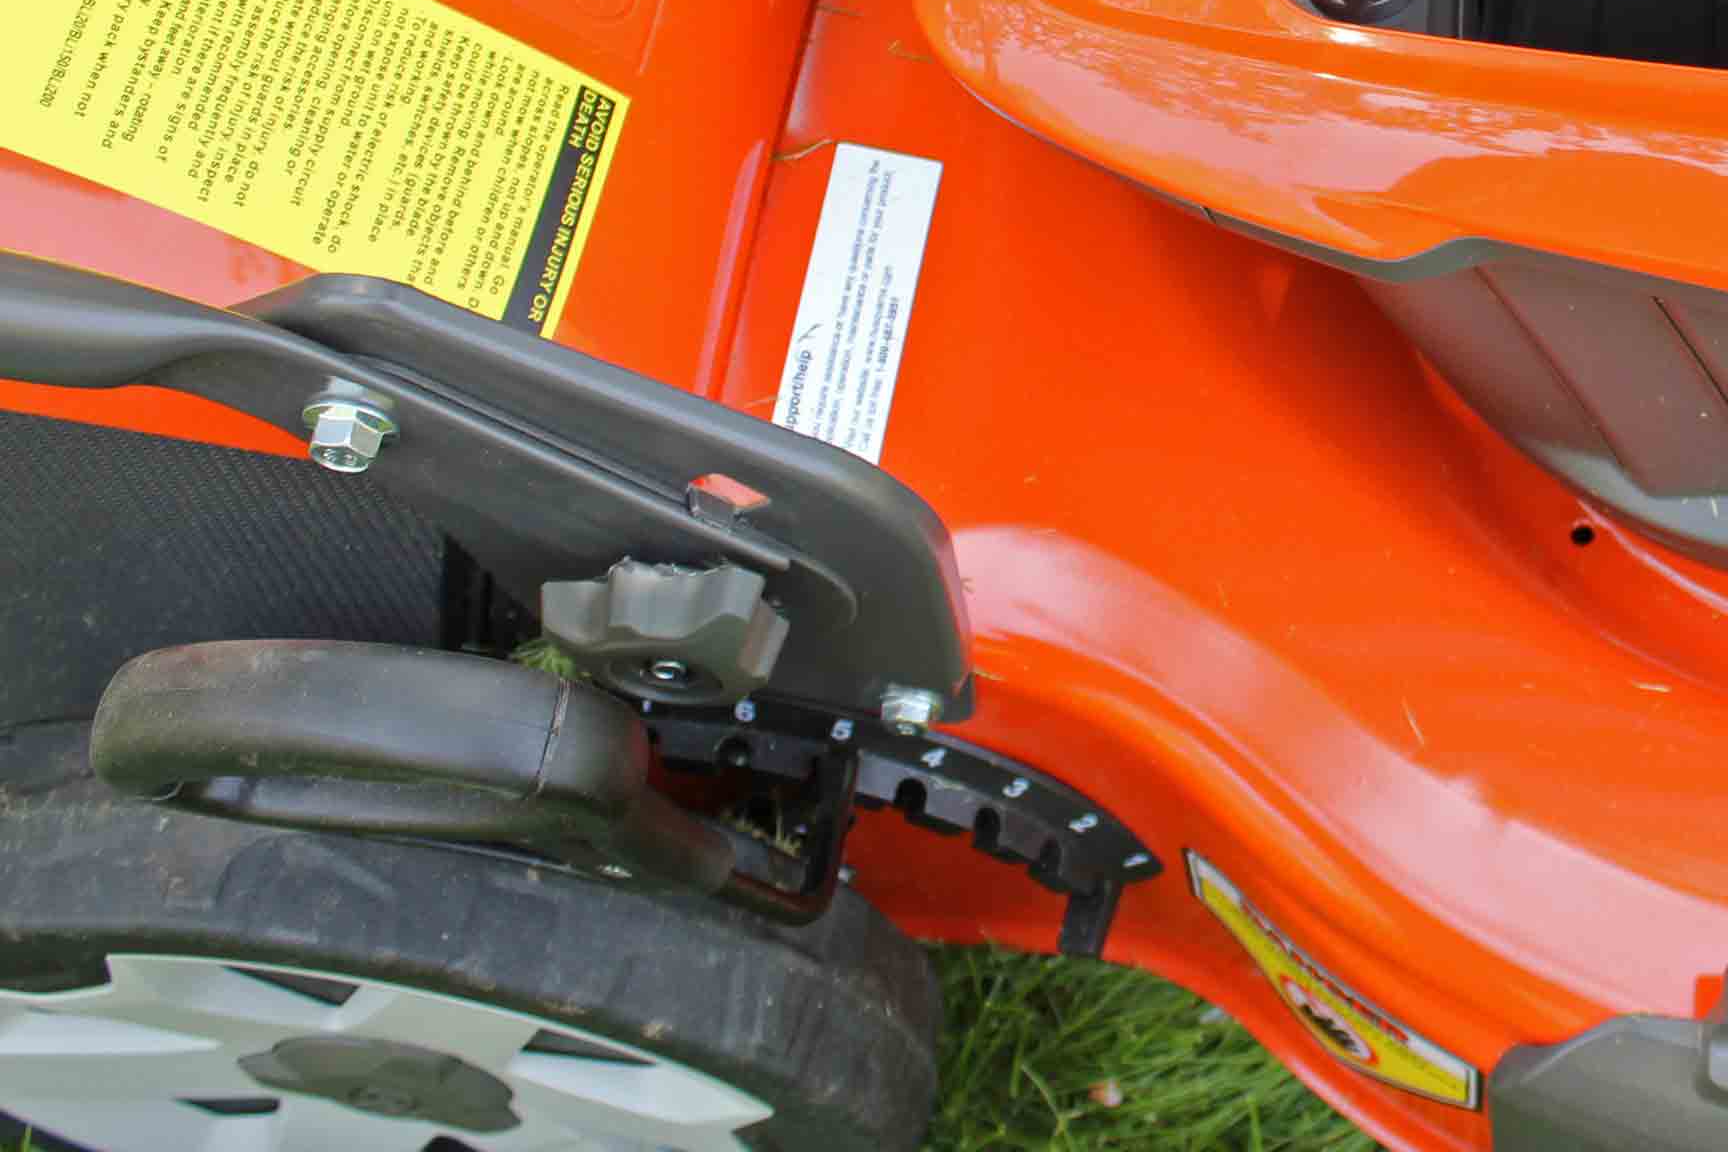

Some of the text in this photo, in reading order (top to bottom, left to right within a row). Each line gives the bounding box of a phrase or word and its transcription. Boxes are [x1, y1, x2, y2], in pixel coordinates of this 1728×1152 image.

[99, 12, 127, 50] pack
[162, 20, 183, 47] feet
[204, 23, 220, 37] if
[226, 3, 265, 72] assembly
[256, 25, 276, 51] the
[368, 27, 383, 48] on
[409, 13, 426, 33] To
[420, 19, 440, 49] and
[145, 44, 170, 81] away
[189, 36, 215, 76] there
[266, 18, 297, 74] without
[288, 39, 309, 65] the
[358, 47, 377, 75] wet
[390, 31, 419, 82] reduce
[445, 32, 470, 72] Keep
[85, 50, 112, 91] when
[110, 35, 157, 119] bystanders
[186, 28, 237, 132] recommended
[245, 50, 266, 80] risk
[277, 64, 299, 95] risk
[510, 61, 524, 85] are
[73, 91, 95, 120] not
[179, 75, 197, 100] are
[237, 80, 254, 99] of
[243, 72, 276, 126] guards
[270, 94, 288, 112] of
[327, 71, 351, 108] from
[380, 81, 401, 111] risk
[429, 69, 457, 115] safety
[530, 75, 553, 123] across
[548, 82, 570, 120] Read
[120, 90, 154, 144] rotating
[159, 100, 189, 144] signs
[196, 72, 238, 149] frequently
[287, 93, 324, 159] cleaning
[307, 5, 410, 247] not expose unit to water or operate
[373, 110, 390, 129] of
[419, 40, 484, 196] could be thrown by the
[566, 89, 598, 149] DEATH
[100, 119, 123, 151] and
[240, 125, 256, 142] in
[306, 106, 338, 158] supply
[411, 115, 441, 170] devices
[540, 118, 558, 142] the
[154, 144, 172, 164] of
[187, 150, 209, 180] and
[243, 158, 263, 181] do
[282, 158, 298, 177] or
[353, 126, 384, 183] electric
[412, 48, 498, 257] while Remove objects
[421, 54, 513, 287] Look down and behind before and
[193, 144, 229, 203] inspect
[290, 157, 319, 208] circuit
[456, 68, 541, 292] not mow when children or others
[503, 175, 521, 201] not
[232, 181, 254, 209] not
[381, 186, 397, 202] in
[494, 199, 511, 220] up
[526, 96, 613, 323] AVOID SERIOUS INJURY OR
[363, 201, 391, 244] place
[487, 220, 506, 250] and
[326, 233, 344, 256] do
[487, 273, 505, 297] Go
[734, 698, 757, 723] 6
[831, 719, 854, 741] 5
[921, 747, 947, 768] 4
[1003, 777, 1029, 798] 3
[1068, 812, 1099, 833] 2
